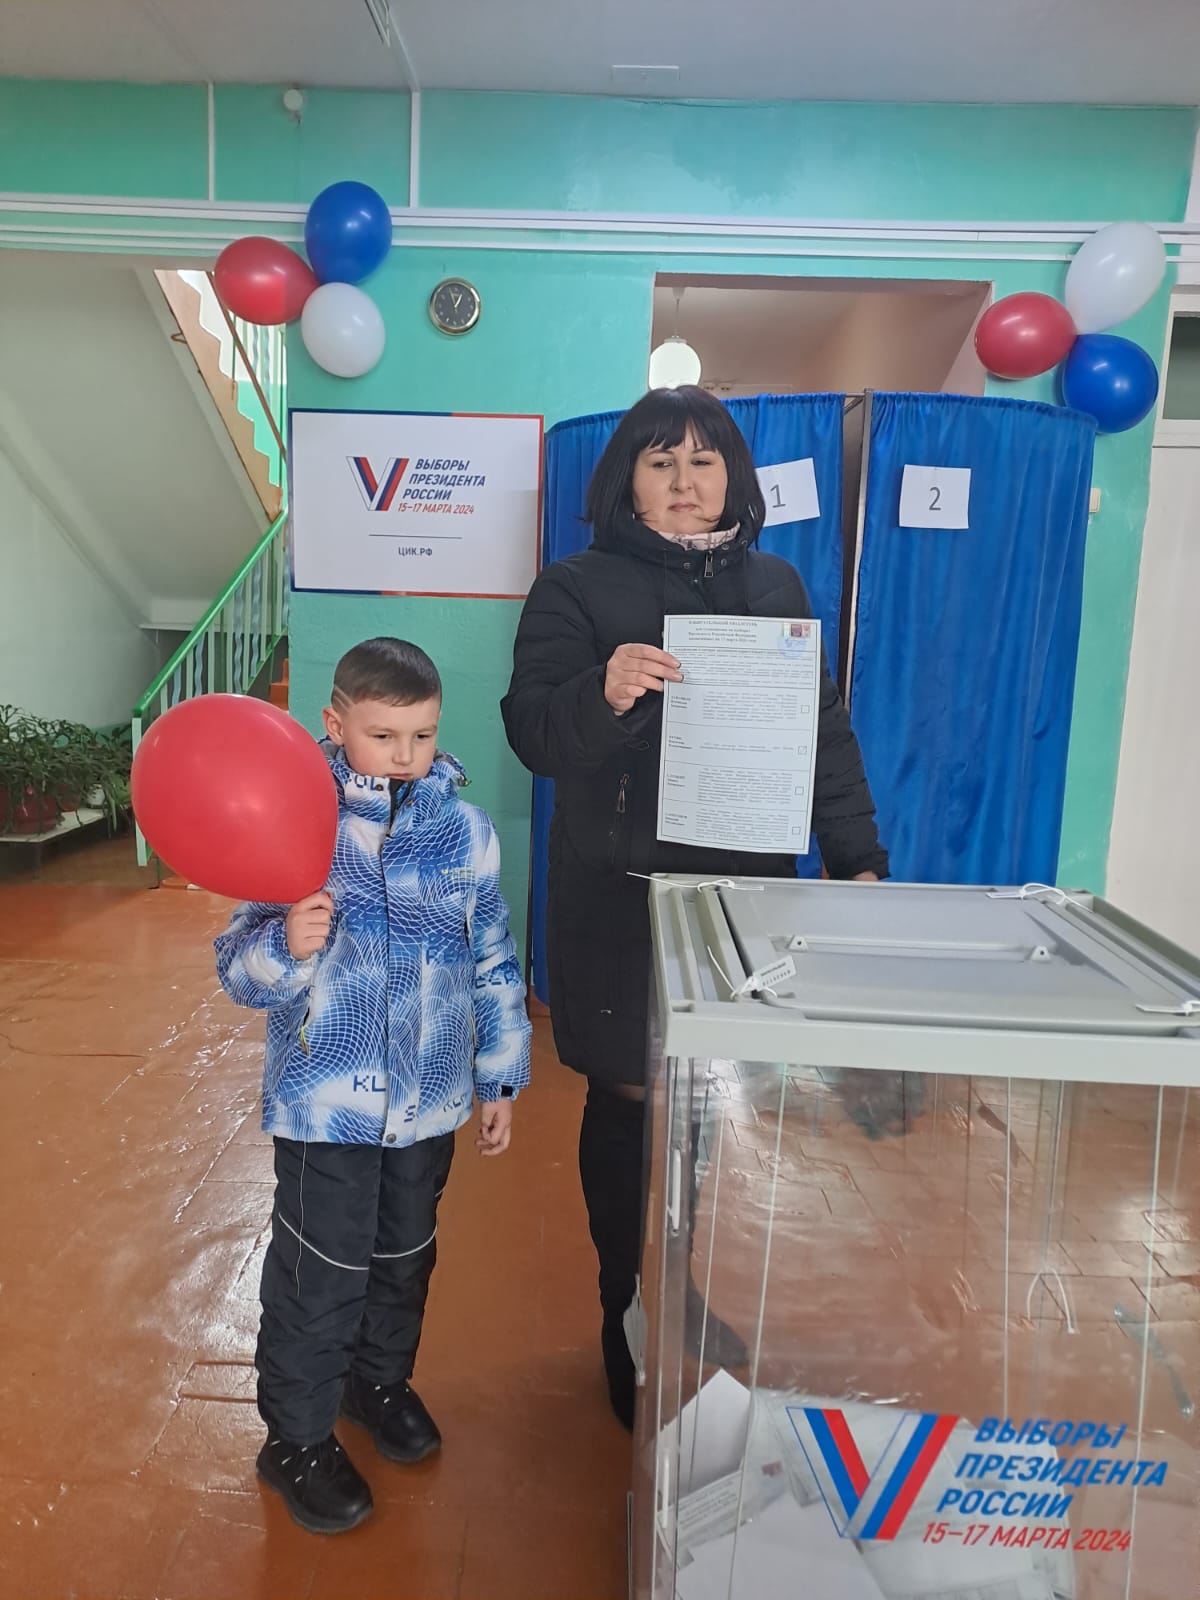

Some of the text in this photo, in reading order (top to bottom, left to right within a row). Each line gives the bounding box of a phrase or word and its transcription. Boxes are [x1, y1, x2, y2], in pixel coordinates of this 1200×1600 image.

[415, 458, 470, 471] ВЫБОРЫ
[408, 473, 486, 487] ПРЕЗИДЕНТА
[402, 488, 452, 500] РОССИИ
[770, 484, 786, 509] 1
[928, 486, 942, 511] 2
[422, 503, 452, 513] МАРТА
[453, 504, 474, 514] 2024
[398, 547, 433, 557] ЦИК.РФ
[974, 1416, 1128, 1449] ВЫБОРЫ
[955, 1453, 1169, 1487] ПРЕЗИДЕНТА
[936, 1488, 1074, 1519] РОССИИ
[989, 1525, 1072, 1550] МАРТА
[1073, 1529, 1132, 1552] 2024
